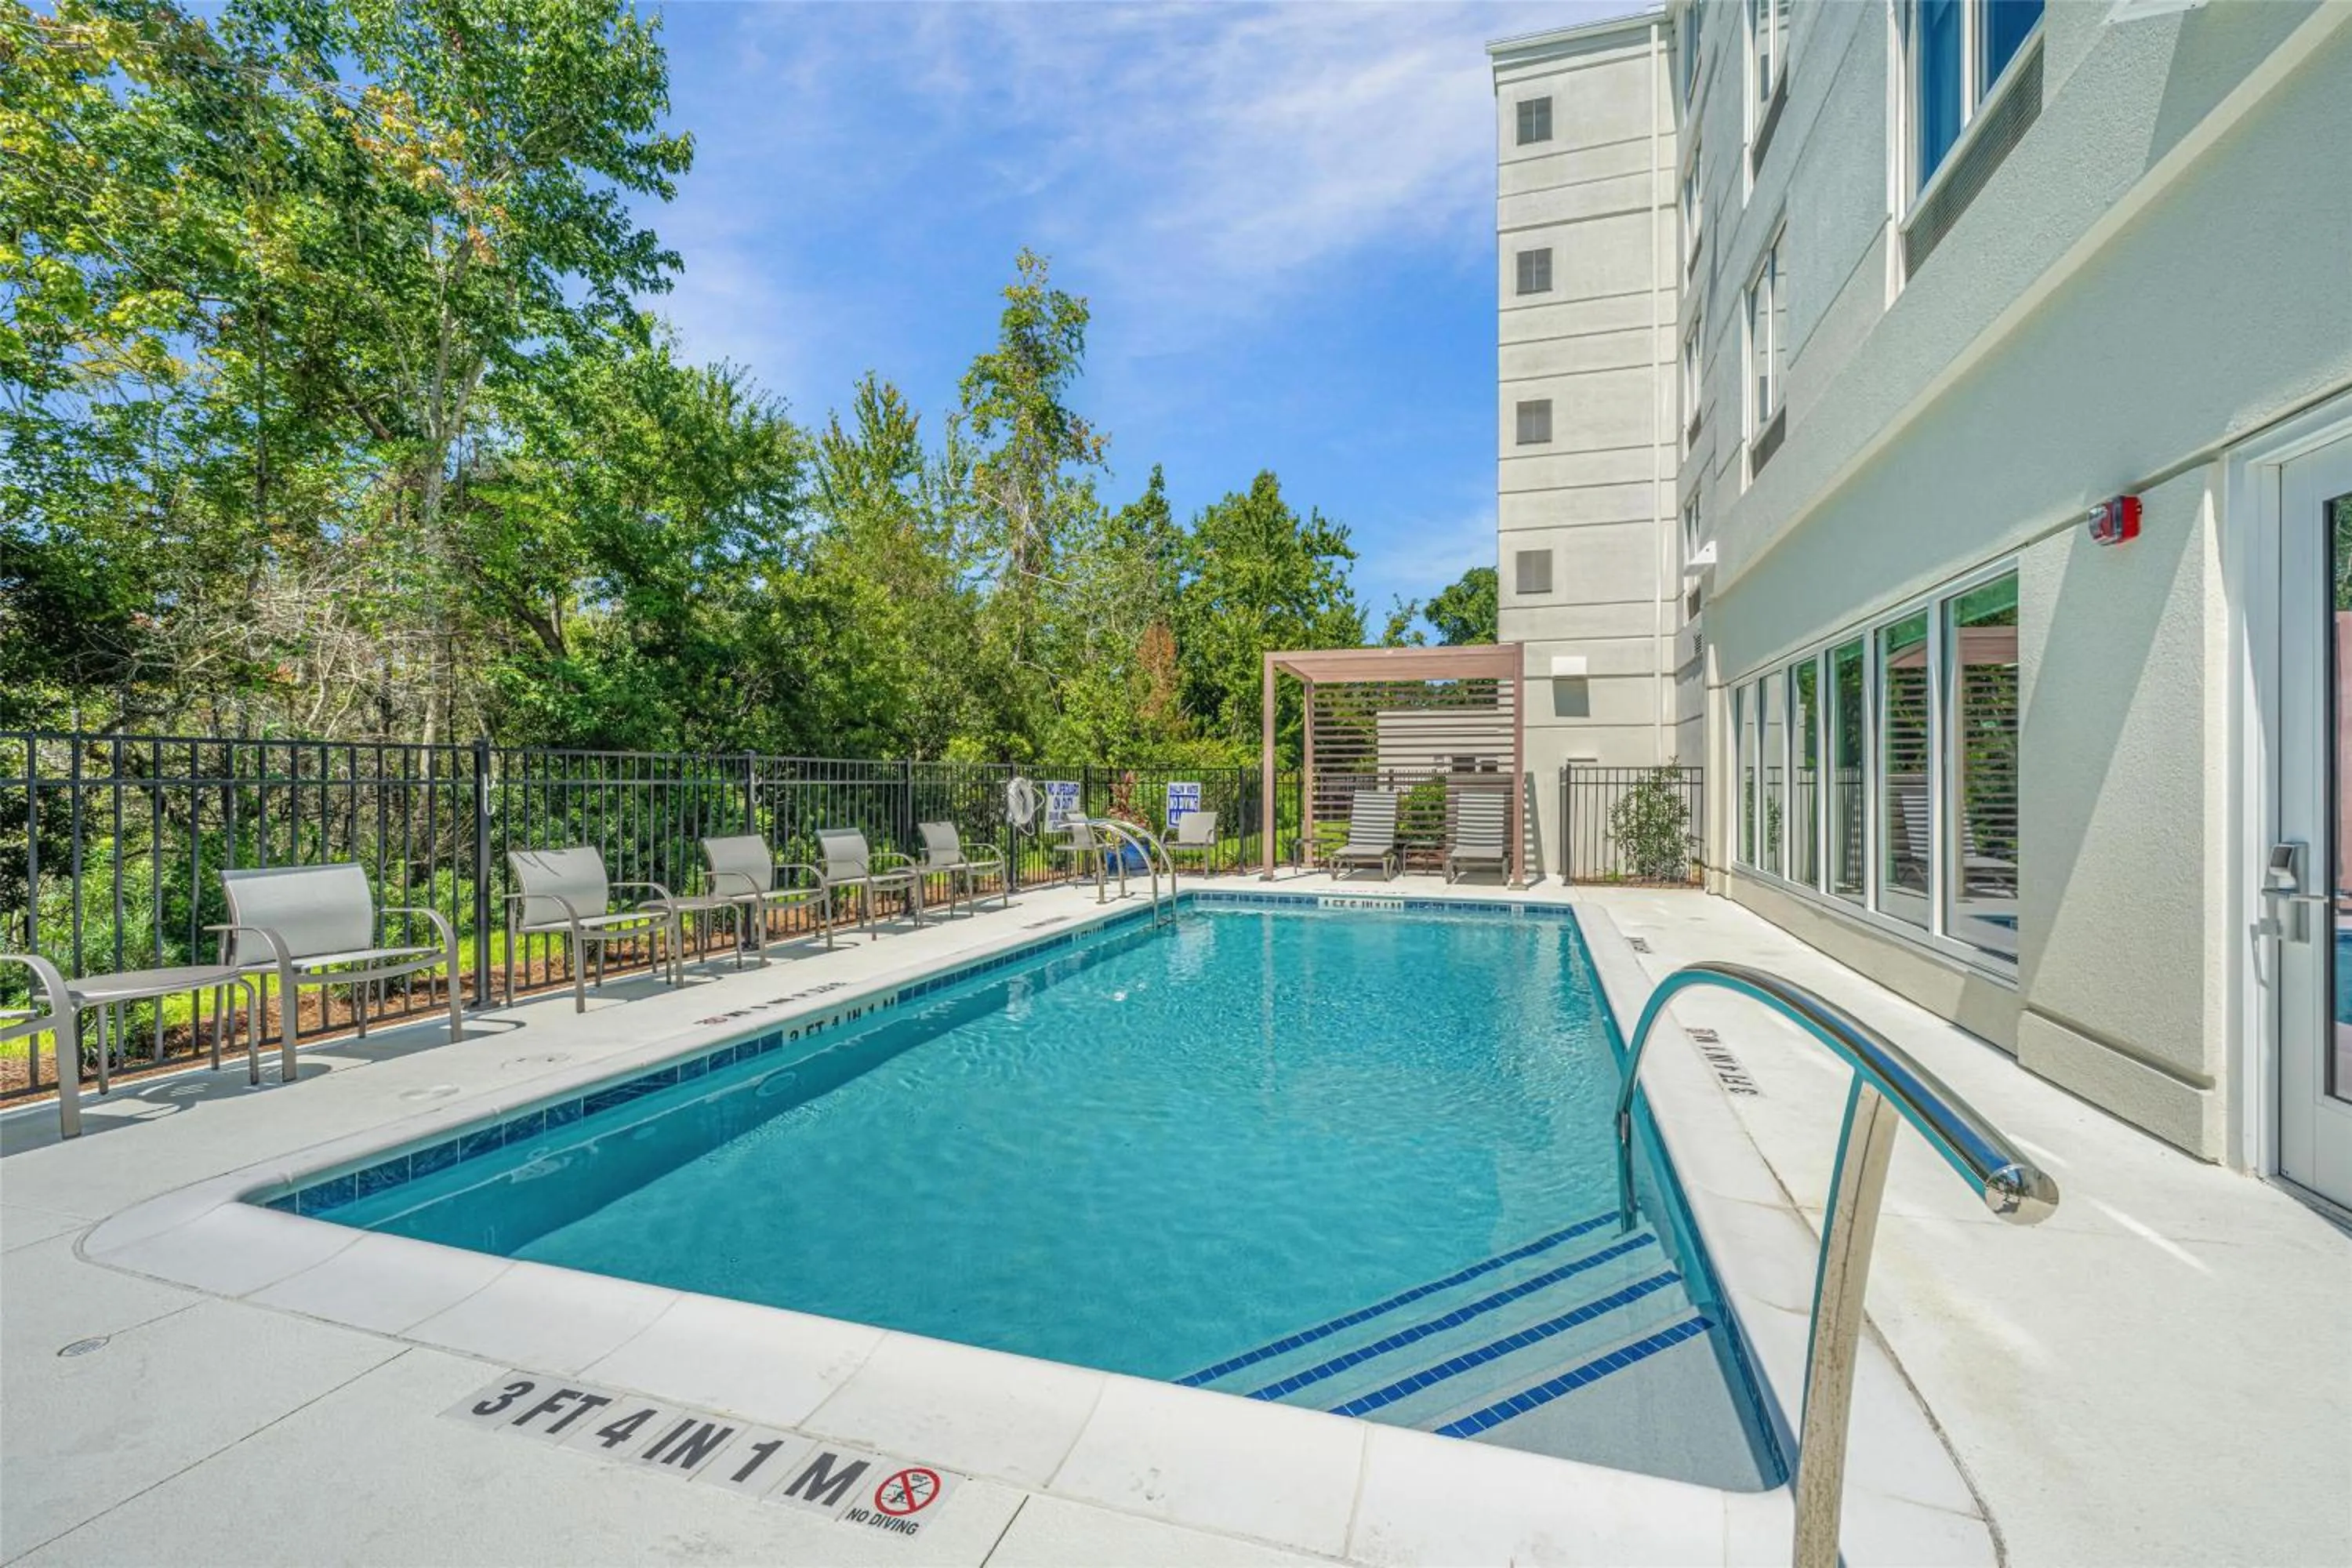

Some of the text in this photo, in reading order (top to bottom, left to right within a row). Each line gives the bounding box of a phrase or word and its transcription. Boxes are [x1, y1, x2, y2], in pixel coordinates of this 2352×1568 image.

[471, 1381, 871, 1507] 3 FT 4 IN 1 M
[845, 1508, 920, 1536] NO DIVING
